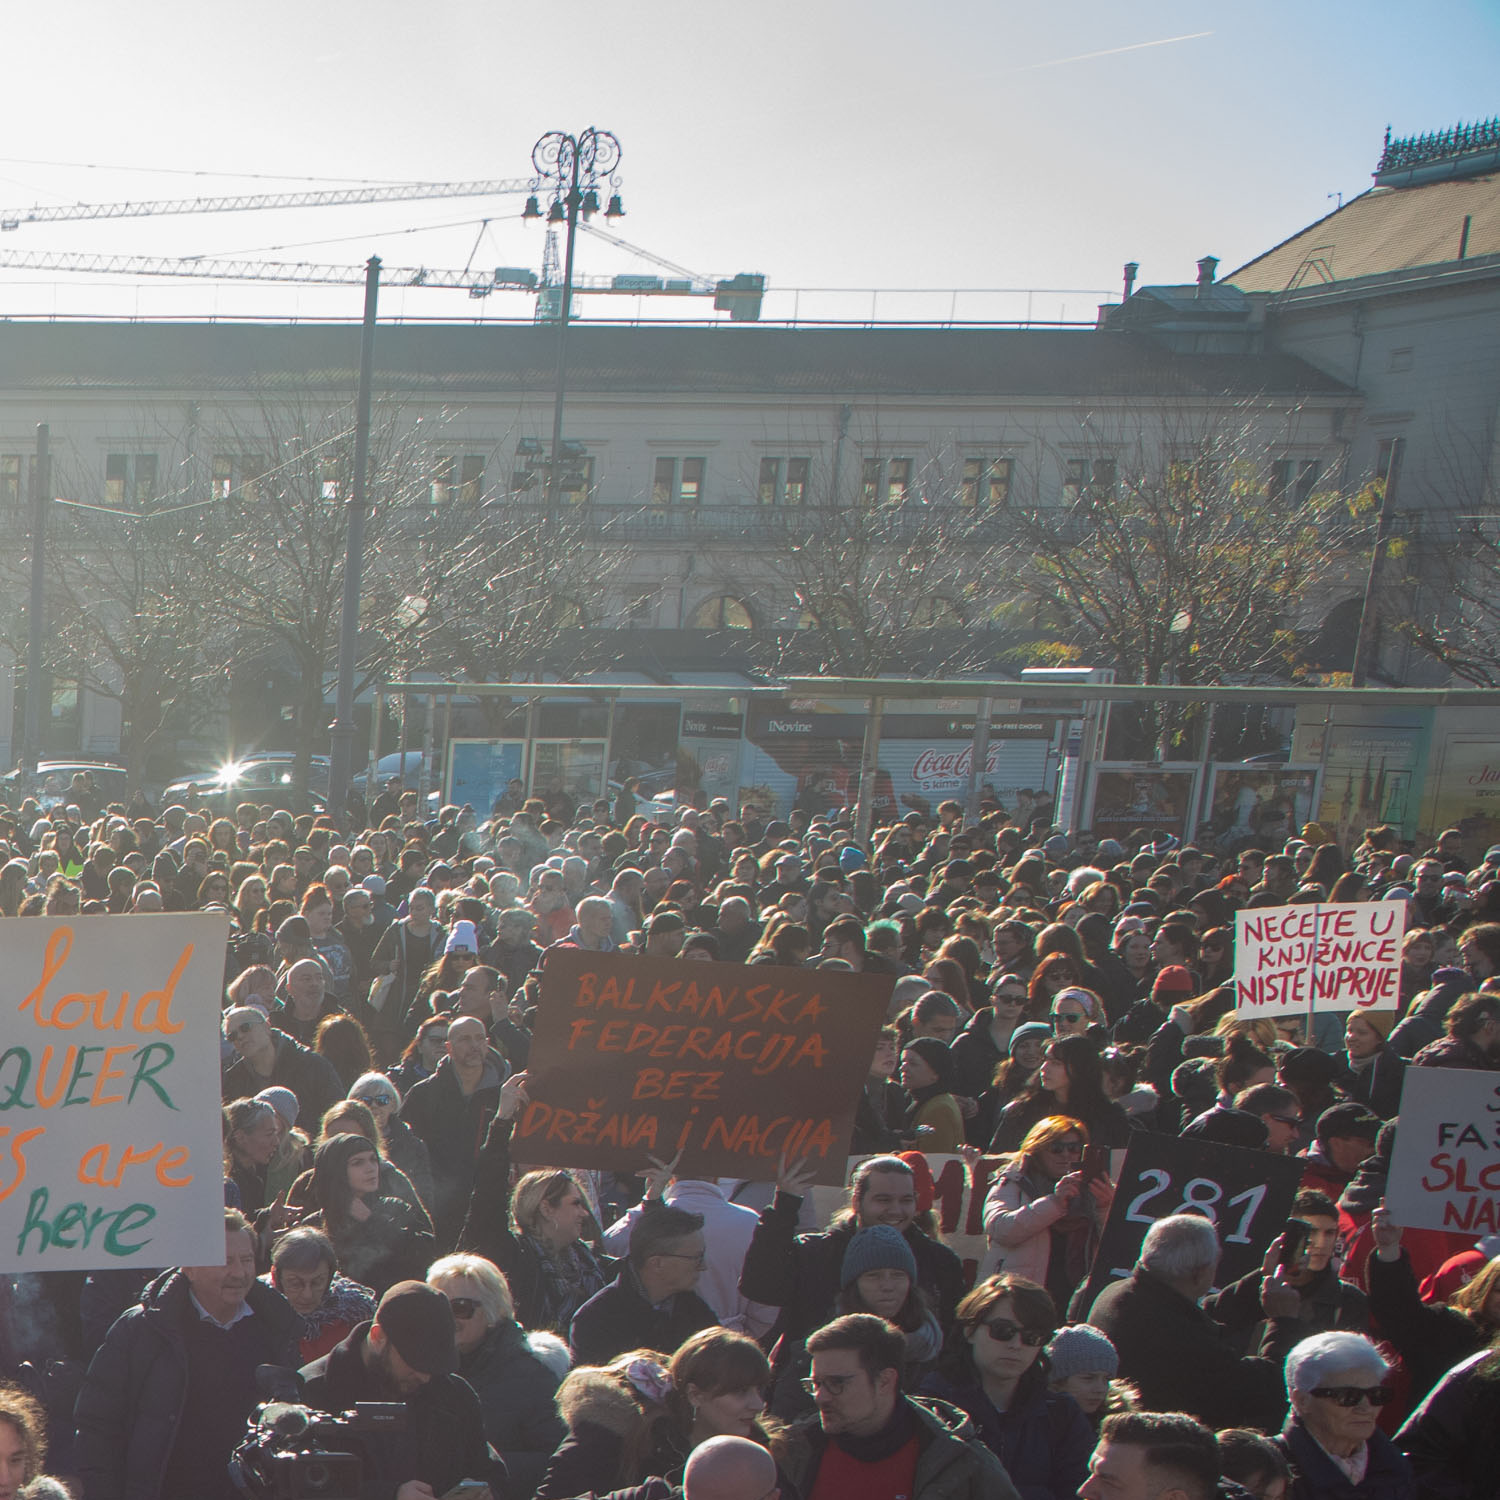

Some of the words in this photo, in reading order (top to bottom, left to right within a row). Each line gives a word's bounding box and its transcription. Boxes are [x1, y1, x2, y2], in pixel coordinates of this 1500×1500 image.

[1244, 909, 1358, 946] NEĆETE
[1369, 910, 1395, 937] U
[1258, 937, 1397, 972] KNJIŽNICE
[18, 925, 195, 1035] loud
[576, 972, 830, 1025] BALKANSKA
[1237, 967, 1307, 1009] NISTE
[568, 1019, 831, 1076] FEDERACIJA
[631, 1068, 725, 1101] BEZ
[519, 1098, 660, 1149] DRŽAVA
[702, 1114, 838, 1166] NACIJA
[78, 1141, 196, 1188] are
[16, 1186, 157, 1258] here
[1125, 1168, 1268, 1245] 281
[1443, 1195, 1500, 1234] NA
